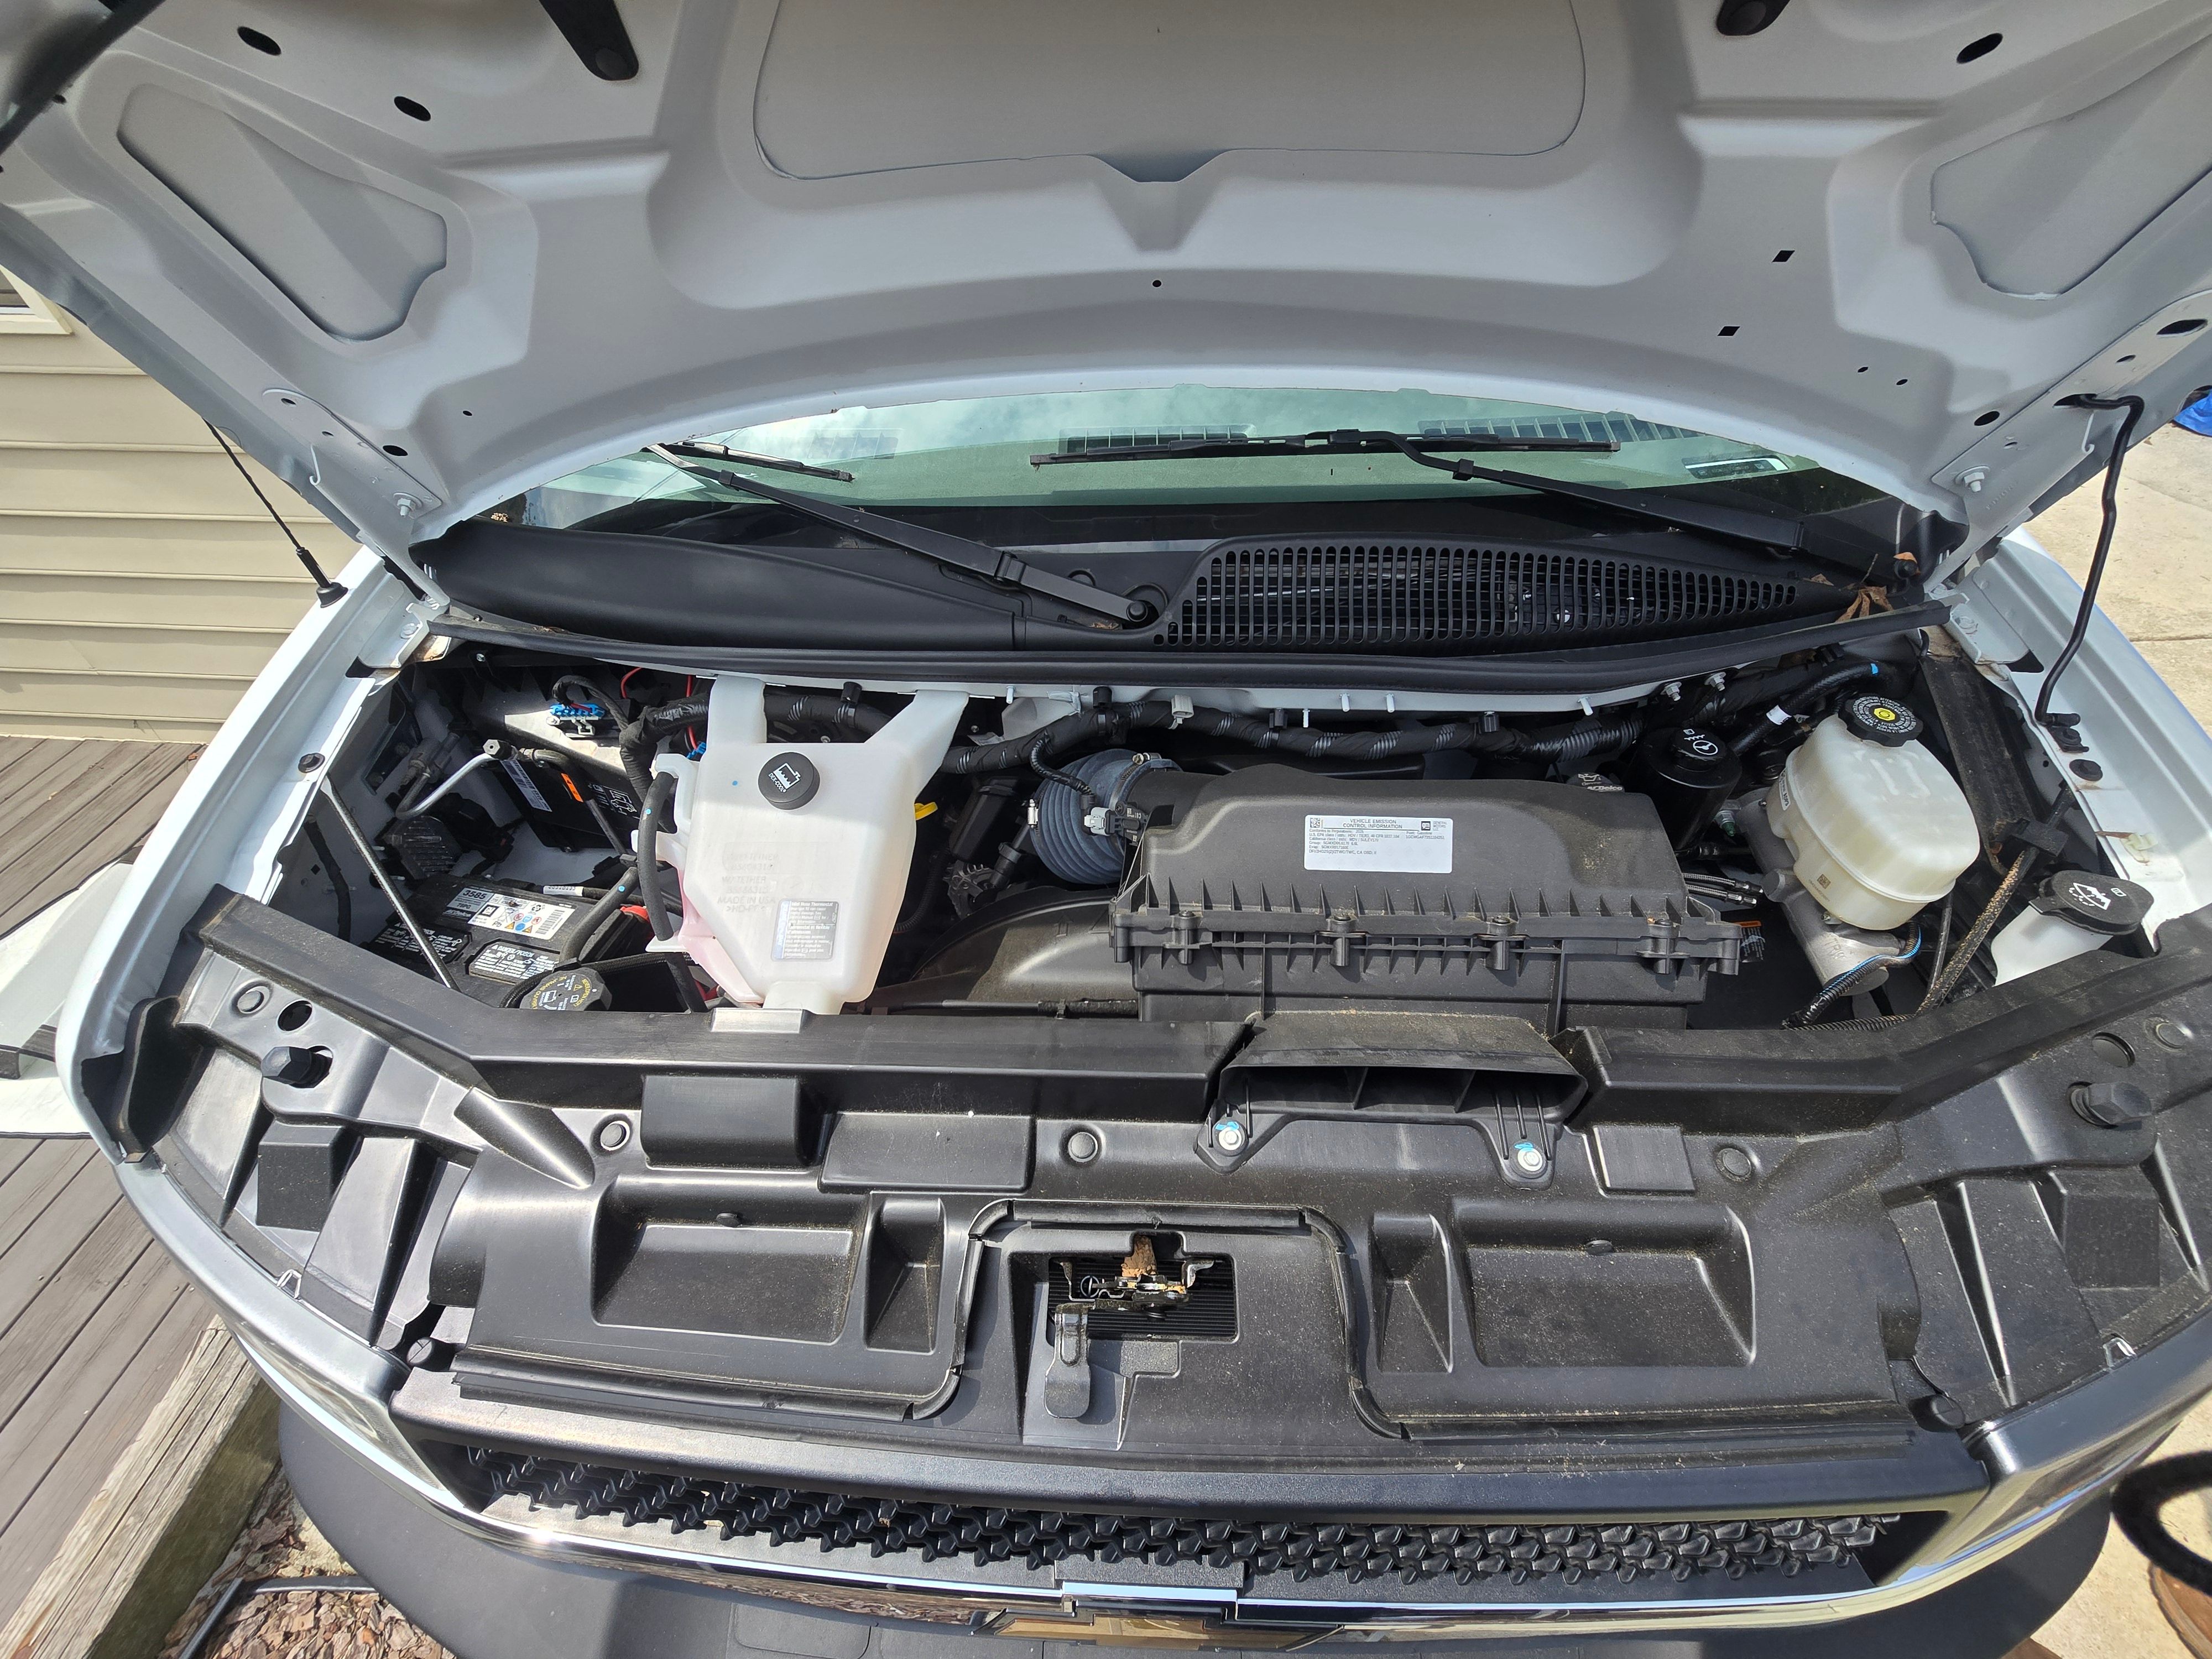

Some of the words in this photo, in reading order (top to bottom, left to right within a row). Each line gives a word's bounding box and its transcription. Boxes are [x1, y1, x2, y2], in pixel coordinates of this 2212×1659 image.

[462, 890, 487, 899] 3585
[717, 896, 745, 904] MADE
[747, 896, 757, 904] IN
[758, 896, 776, 904] USA
